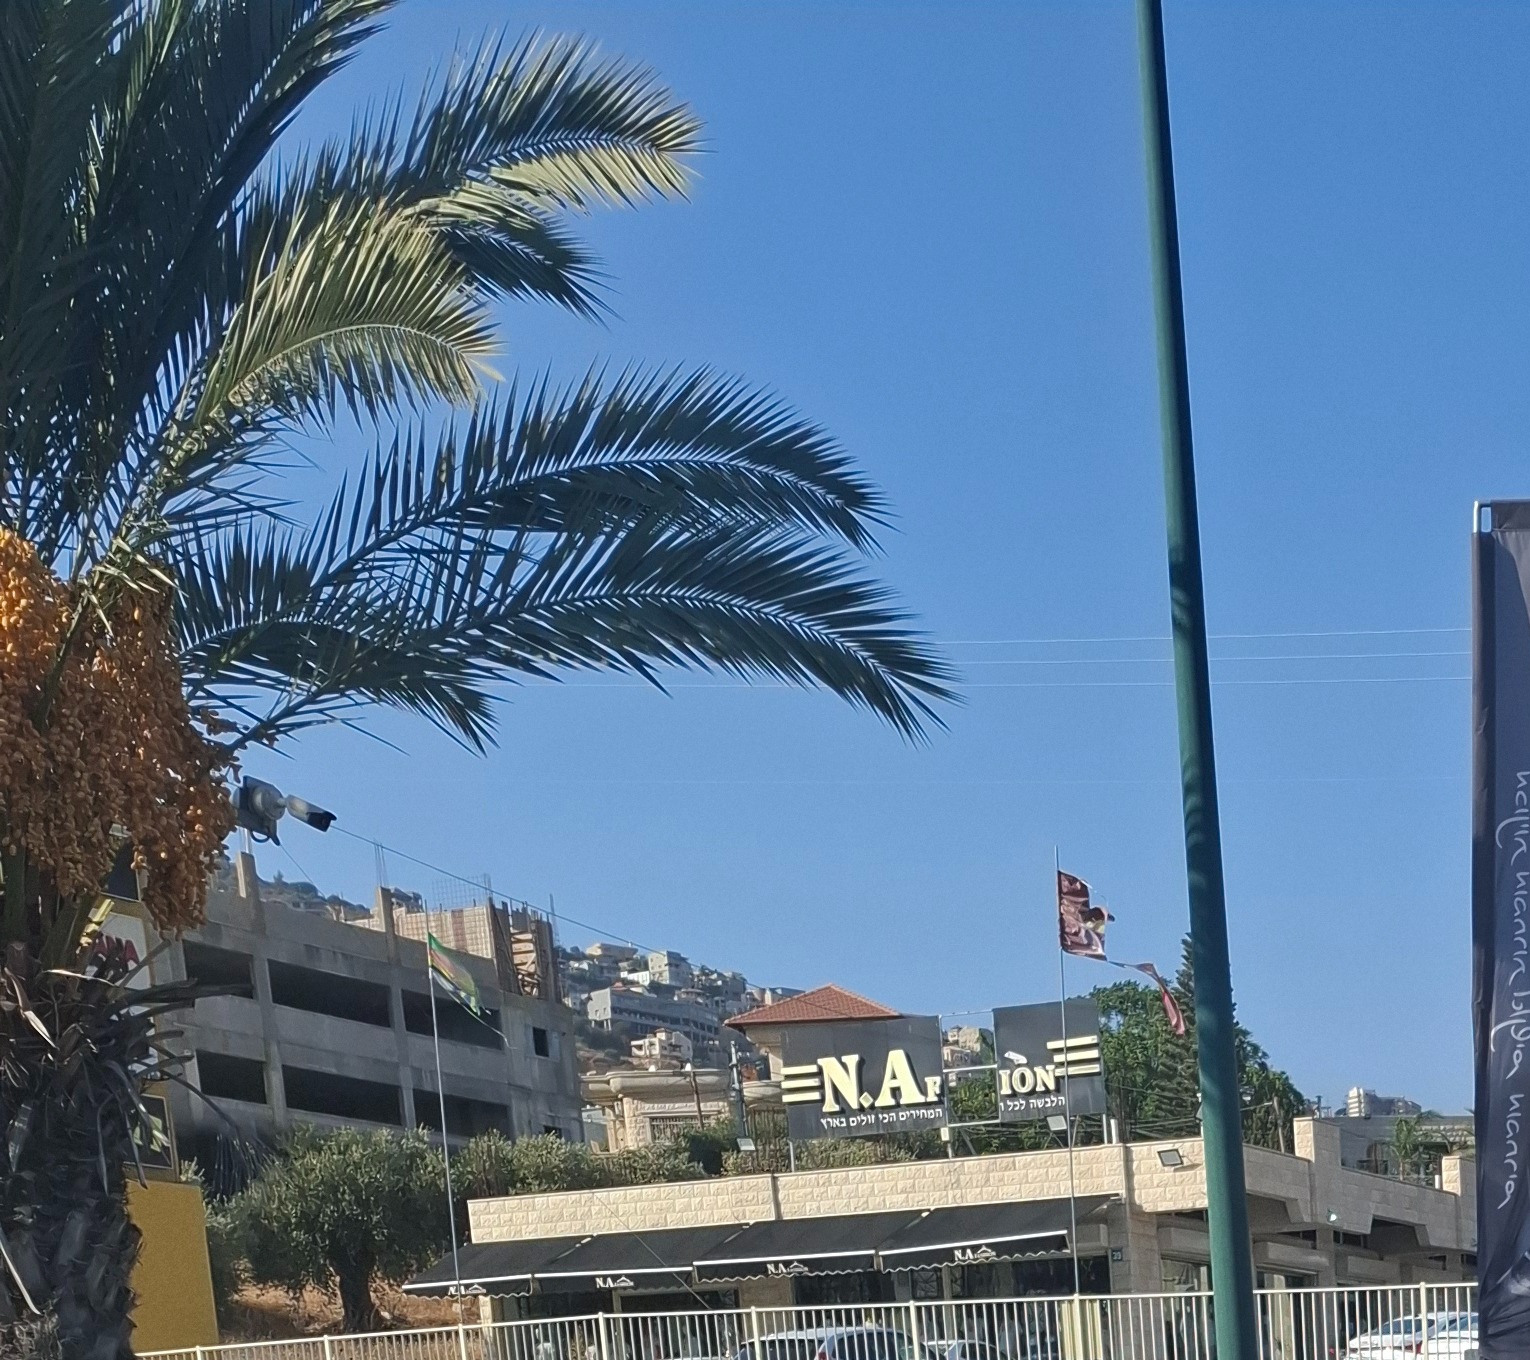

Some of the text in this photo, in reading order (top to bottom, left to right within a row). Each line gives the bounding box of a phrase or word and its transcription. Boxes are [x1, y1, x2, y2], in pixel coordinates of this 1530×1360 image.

[1007, 1097, 1027, 1112] לכל
[1029, 1095, 1066, 1109] הלבשה
[820, 1107, 943, 1131] המחירים הכי זולים בארץ
